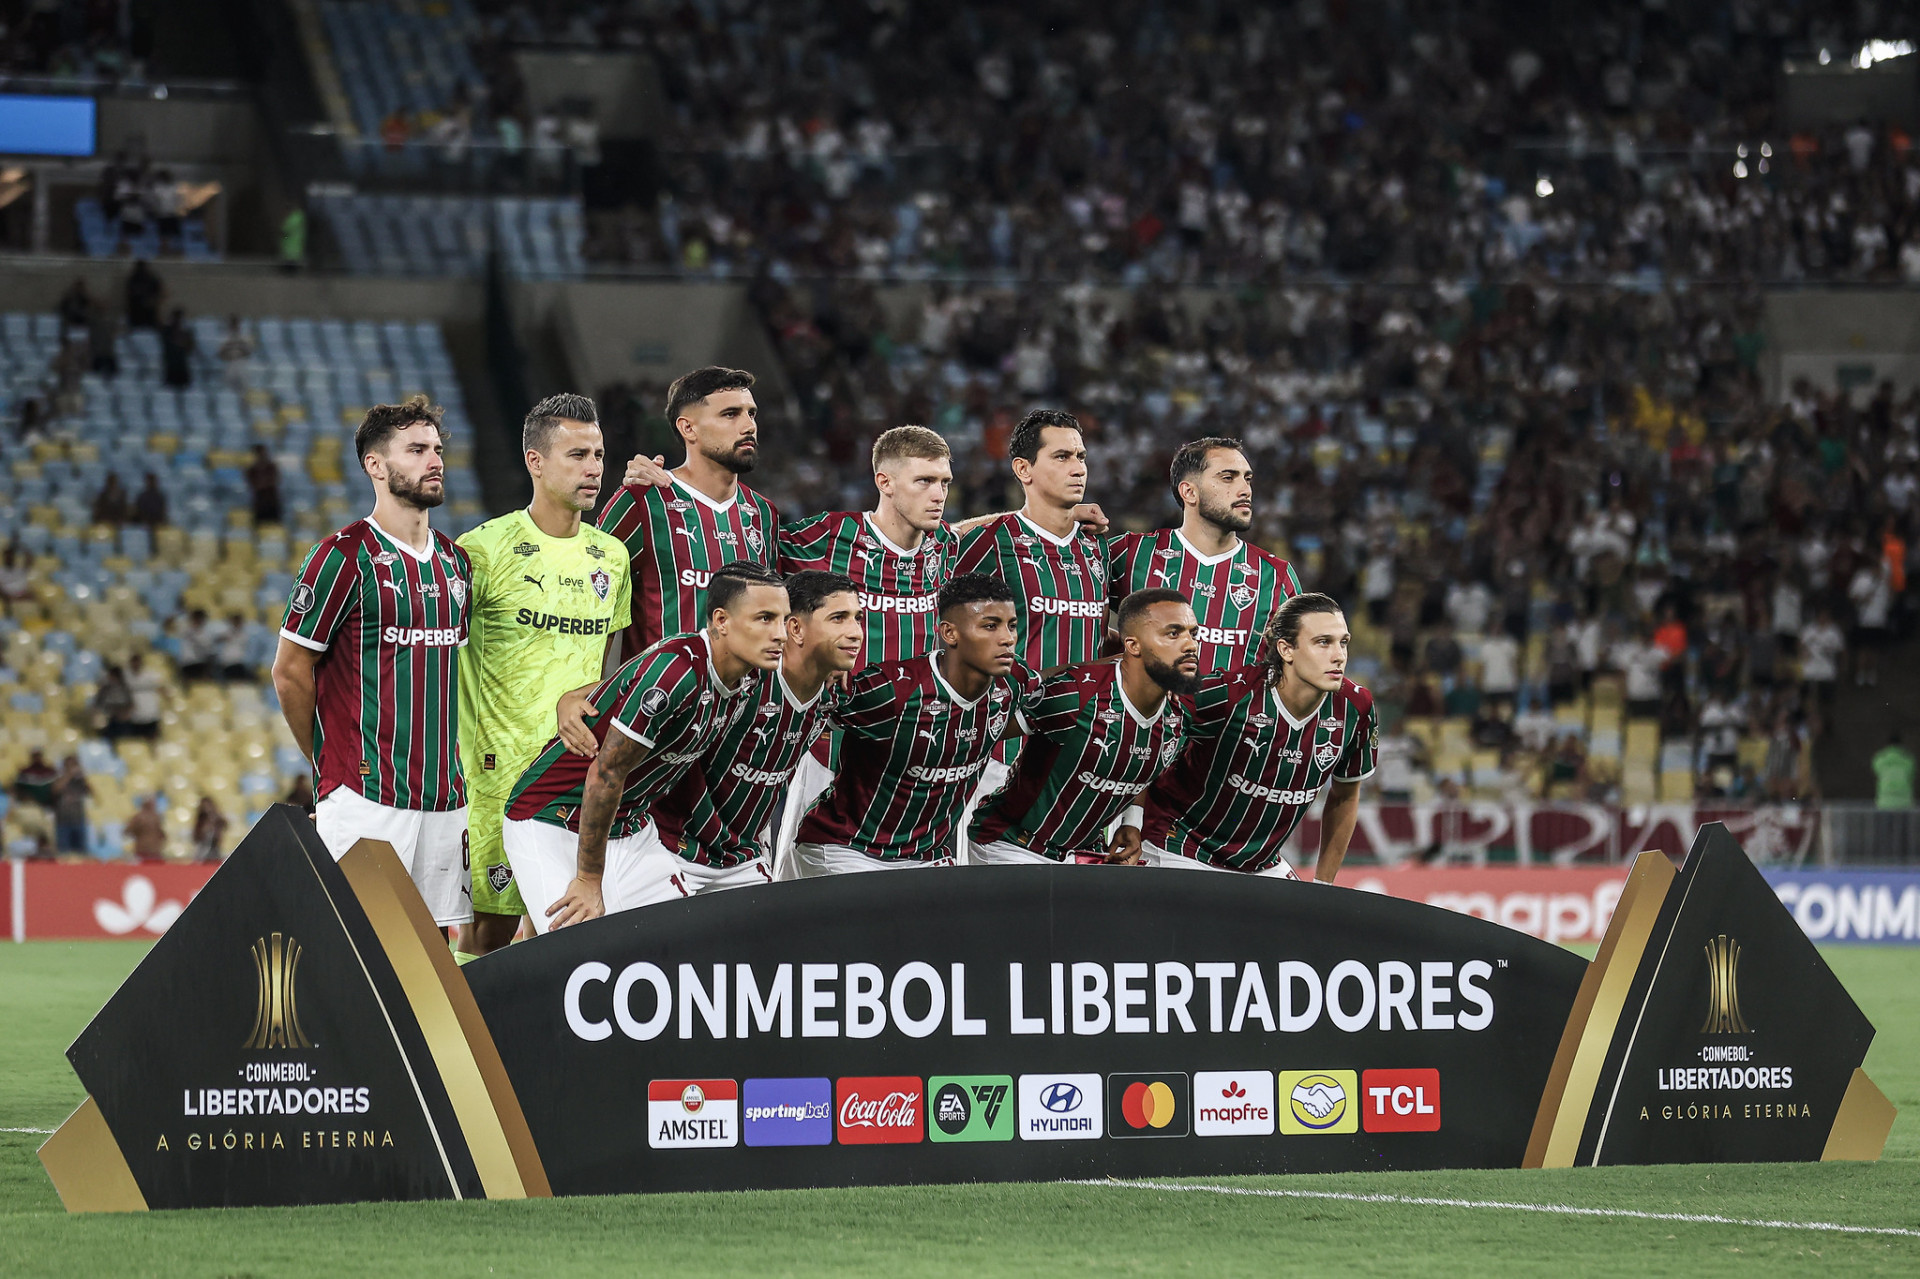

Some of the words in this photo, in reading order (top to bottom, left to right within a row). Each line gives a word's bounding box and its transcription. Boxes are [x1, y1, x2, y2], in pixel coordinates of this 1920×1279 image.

[713, 530, 737, 540] Leve
[892, 560, 916, 570] Leve
[1057, 561, 1081, 571] Leve
[416, 582, 440, 592] Leve
[559, 575, 584, 587] Leve
[680, 569, 714, 588] SU
[1189, 578, 1216, 593] Leve
[515, 608, 611, 635] SUPERBET
[782, 730, 803, 741] Leve
[955, 727, 978, 738] Leve
[1129, 745, 1152, 755] Leve
[1278, 748, 1303, 758] Leve
[564, 961, 987, 1041] CONMEBOL
[1009, 959, 1494, 1034] LIBERTADORES
[1658, 1066, 1793, 1090] LIBERTADORES
[184, 1087, 370, 1115] LIBERTADORES
[940, 1094, 965, 1112] EA
[1368, 1086, 1434, 1115] TCL
[745, 1102, 829, 1122] sportingbet
[840, 1092, 919, 1128] Coca-Cola
[939, 1112, 965, 1121] SPORTS
[1200, 1103, 1268, 1124] mapfre
[1639, 1106, 1649, 1120] A
[1661, 1102, 1732, 1120] GLÓRIA
[1745, 1103, 1811, 1118] ETERNA
[659, 1119, 728, 1140] AMSTEL
[1031, 1117, 1092, 1131] HYUNDAI
[156, 1134, 169, 1151] A
[187, 1128, 285, 1150] GLÓRIA
[303, 1130, 394, 1148] ETERNA
